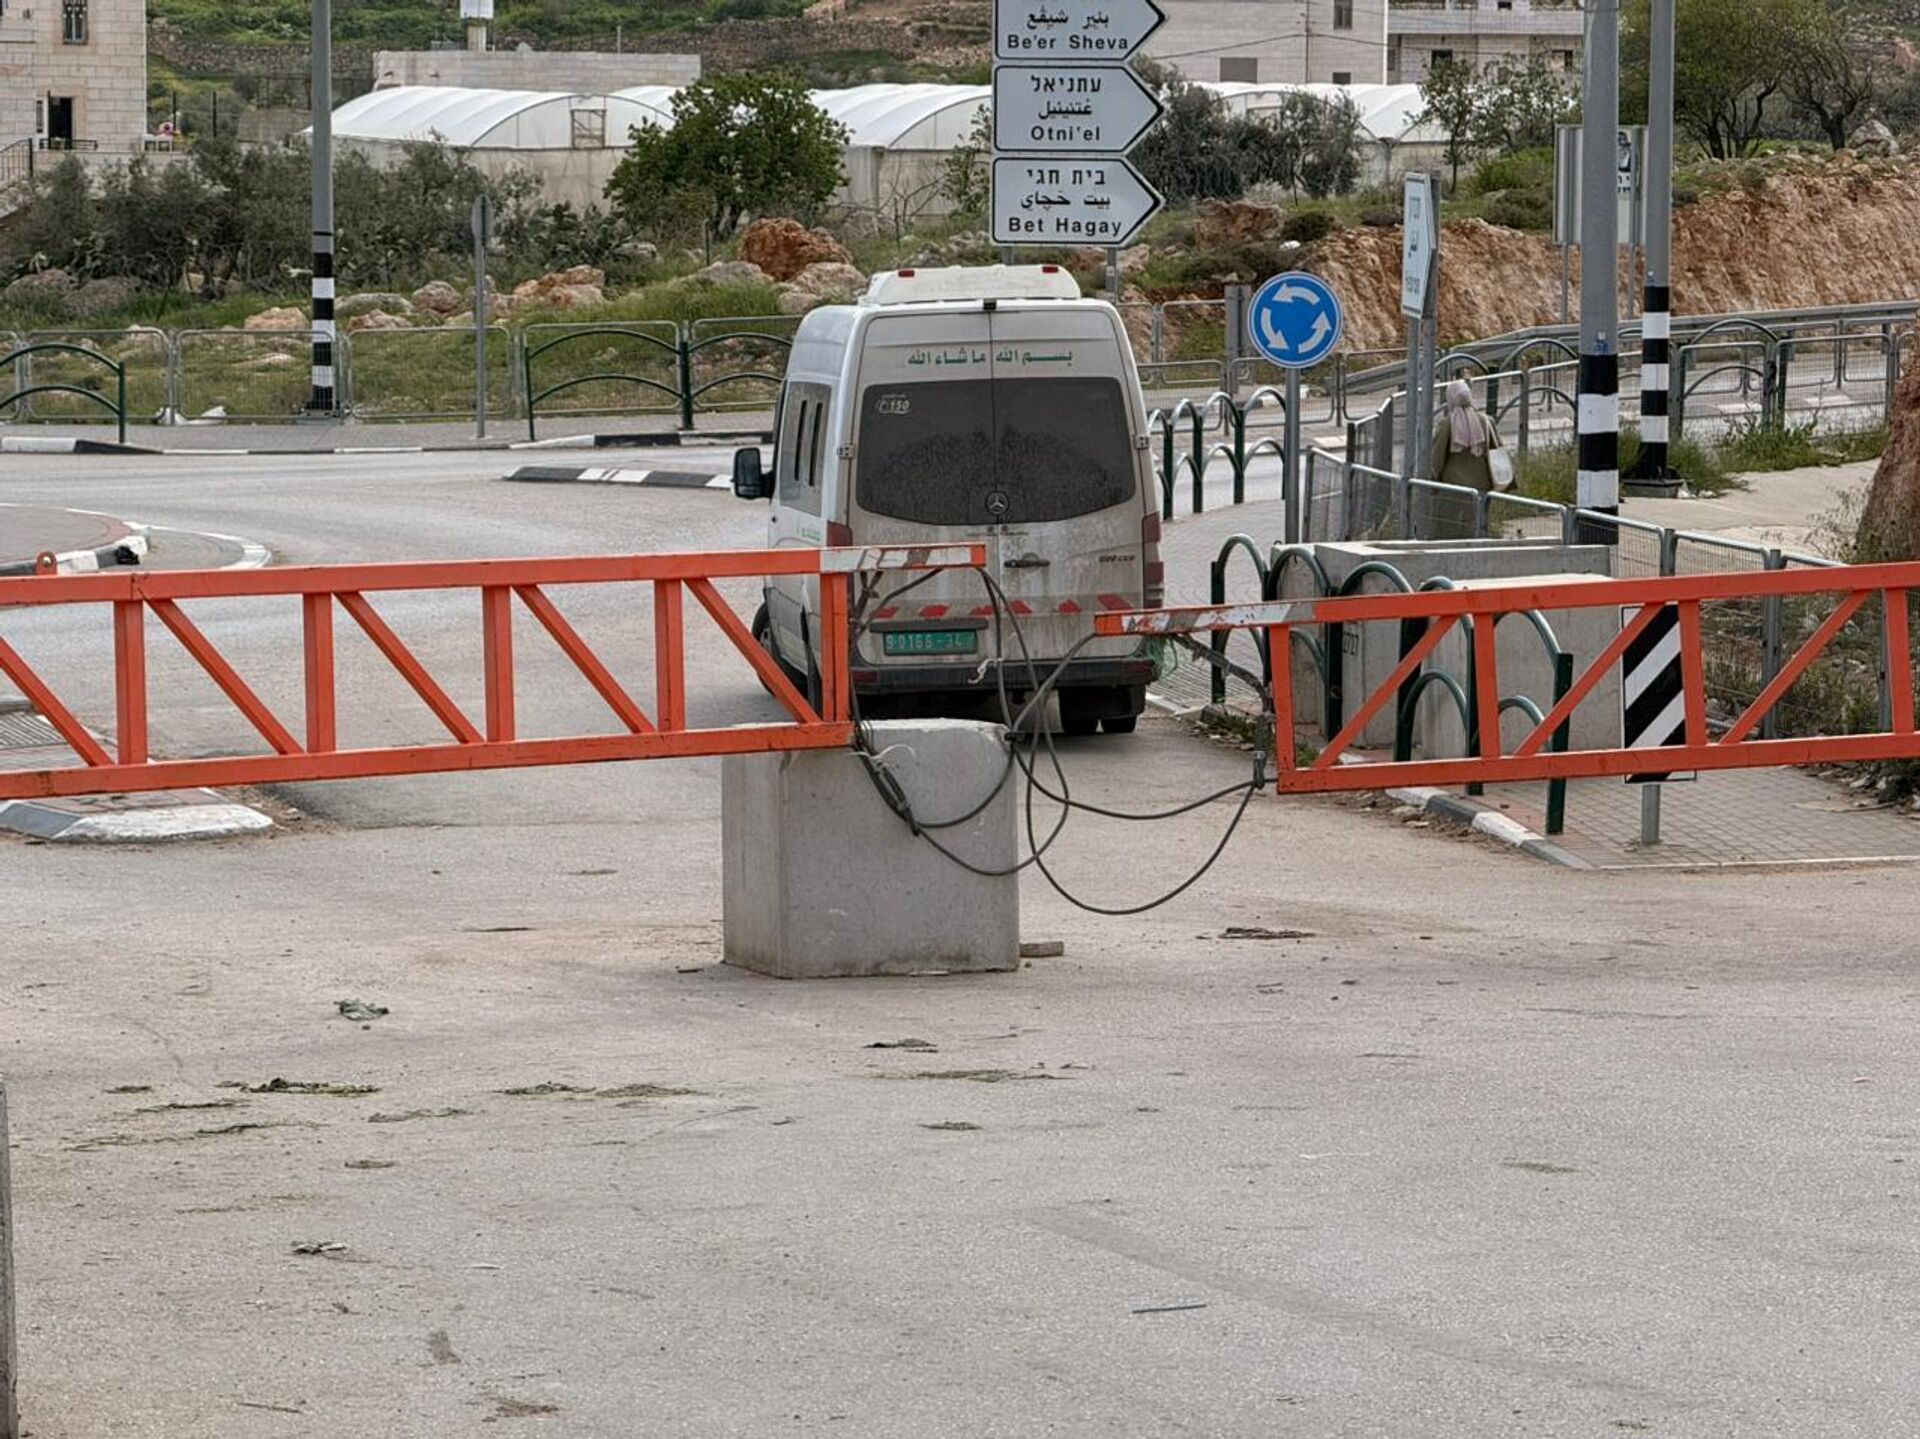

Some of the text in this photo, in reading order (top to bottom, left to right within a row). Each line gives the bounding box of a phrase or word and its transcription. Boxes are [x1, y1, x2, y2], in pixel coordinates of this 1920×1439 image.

[1007, 34, 1128, 49] Be'er Sheva
[1031, 74, 1101, 92] עתניאל
[1031, 126, 1100, 141] Otni'el
[1026, 169, 1105, 185] בית חגי
[1083, 194, 1111, 210] بيت
[1008, 217, 1121, 237] Bet Hagay
[908, 347, 1073, 367] بسم الله ما شاء الله
